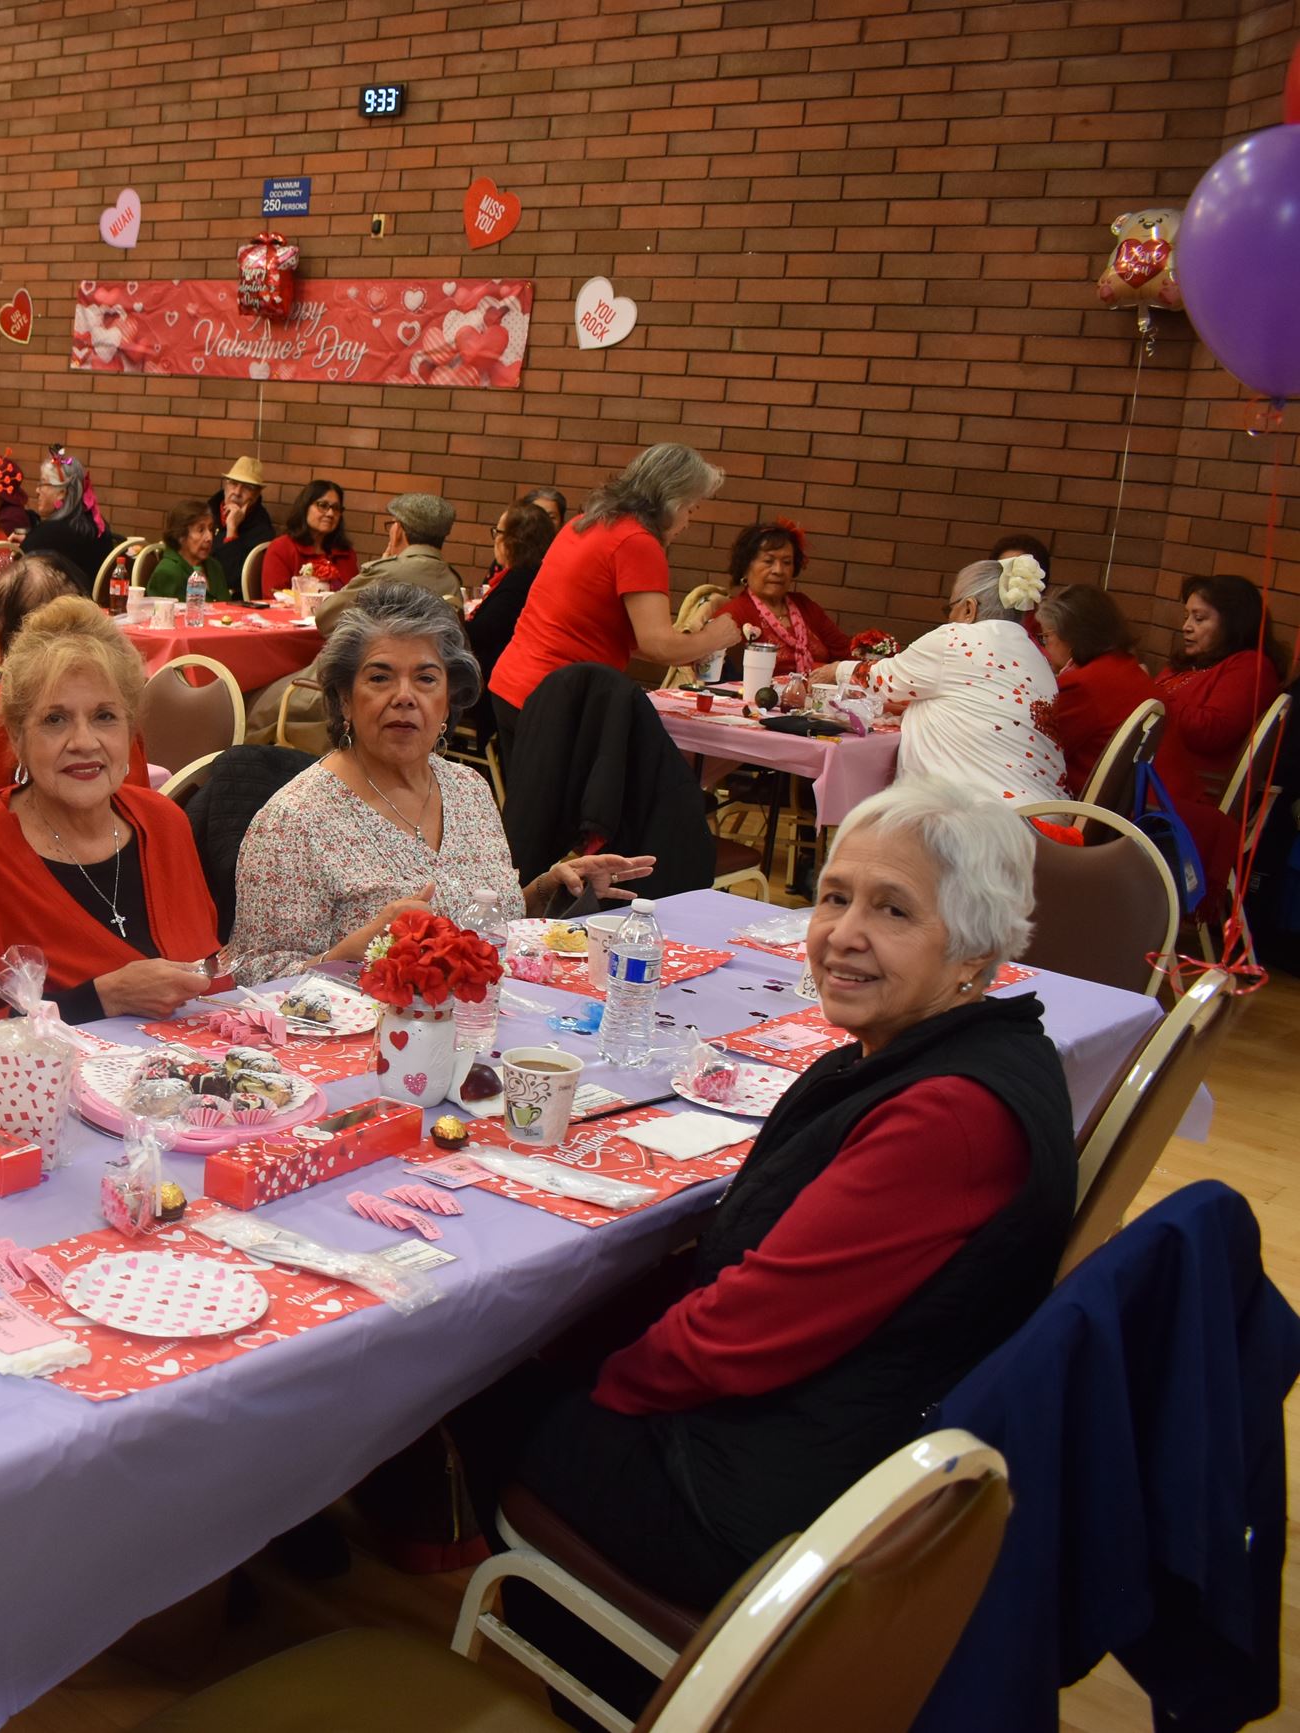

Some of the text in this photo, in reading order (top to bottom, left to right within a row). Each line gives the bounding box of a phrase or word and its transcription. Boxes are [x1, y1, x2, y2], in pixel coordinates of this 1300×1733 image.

[364, 88, 396, 113] 9:33
[269, 190, 303, 198] OCCUPANCY
[273, 181, 300, 189] MAXIMUM
[263, 198, 308, 212] 250 PERSONS
[479, 193, 506, 221] MISS
[109, 206, 135, 238] MUAH
[474, 210, 497, 234] YOU
[594, 298, 617, 325] YOU
[10, 313, 29, 335] CUTE
[579, 311, 610, 343] ROCK
[193, 318, 369, 379] Valentine's Day
[553, 1127, 618, 1169] Valentine's
[58, 1243, 96, 1262] Love
[285, 1283, 342, 1306] Valentine
